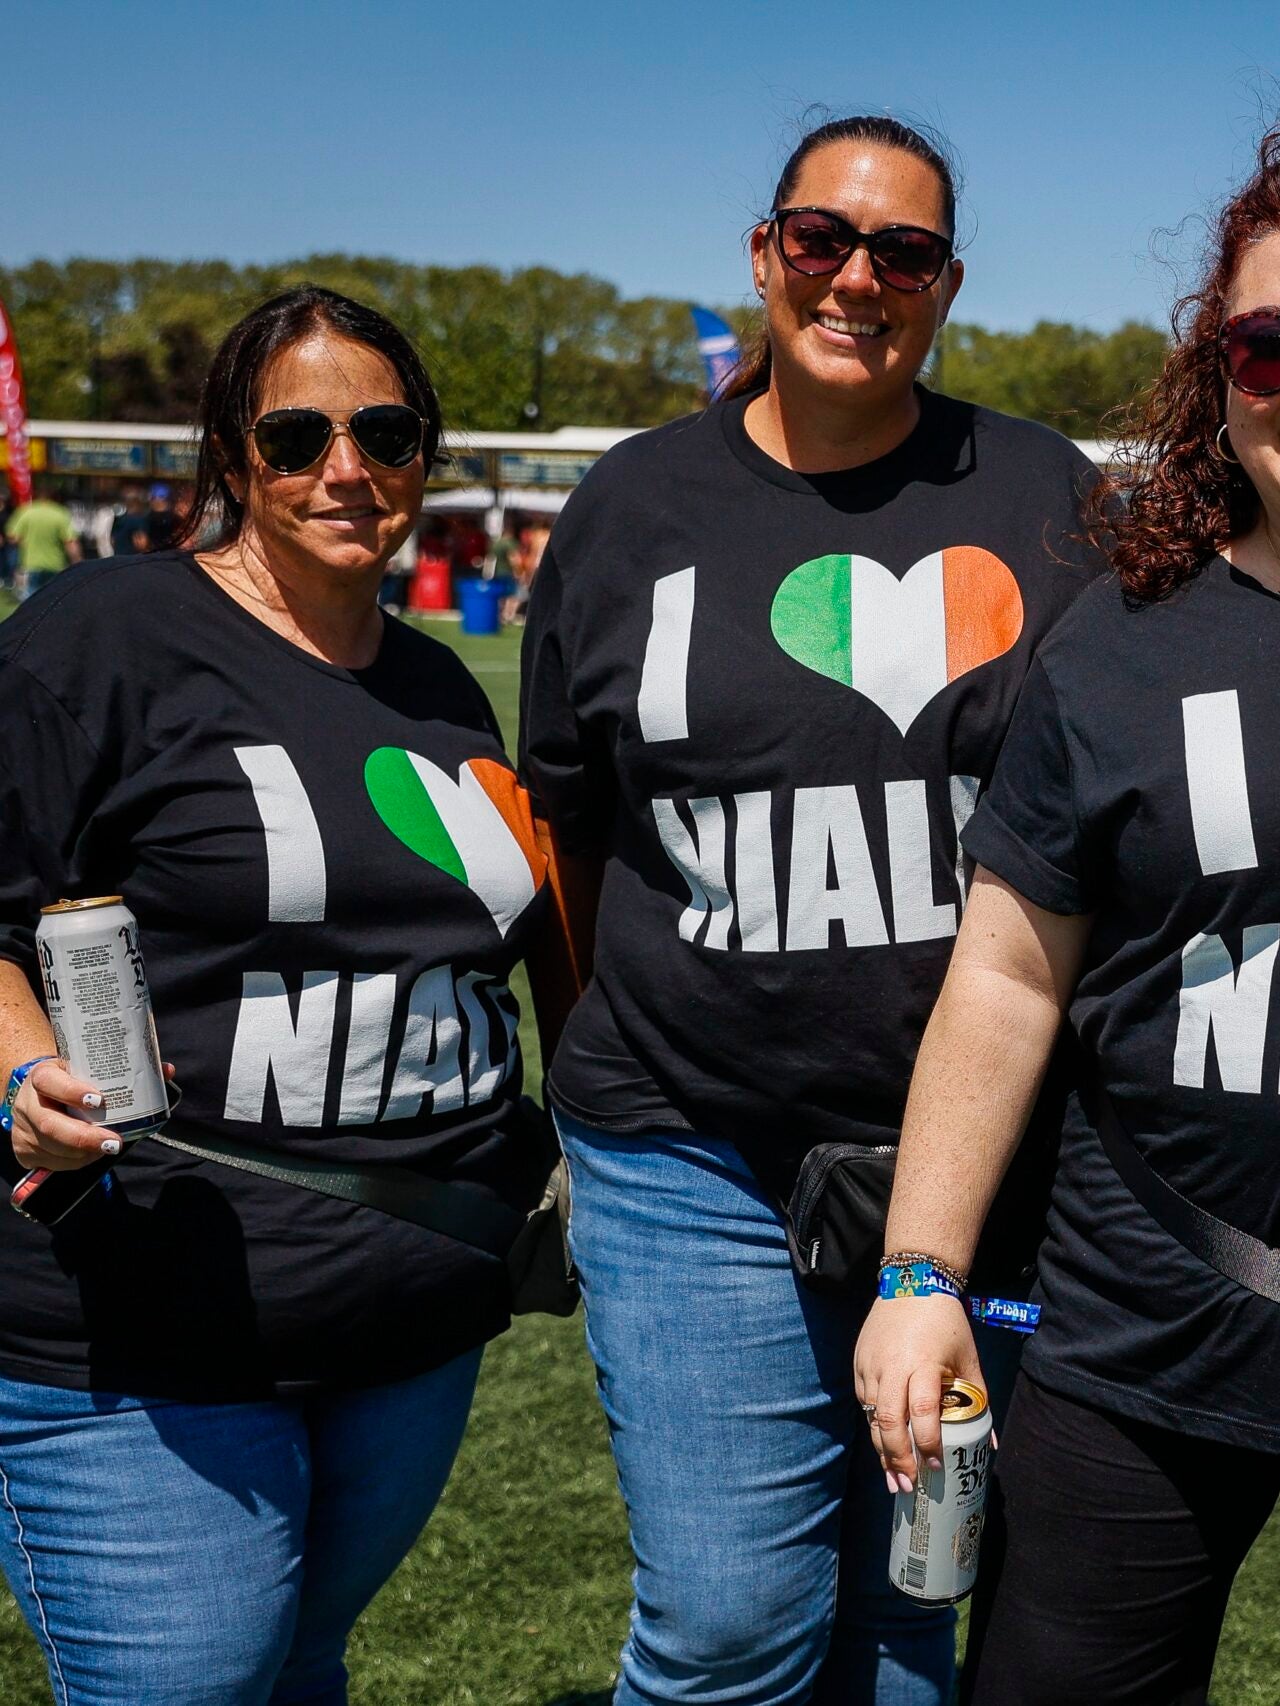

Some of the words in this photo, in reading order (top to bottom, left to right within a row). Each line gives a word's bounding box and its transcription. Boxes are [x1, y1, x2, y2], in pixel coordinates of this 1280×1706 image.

[638, 566, 695, 743] I
[233, 744, 326, 922] I
[1182, 689, 1258, 876] I
[987, 1301, 1028, 1322] Friday
